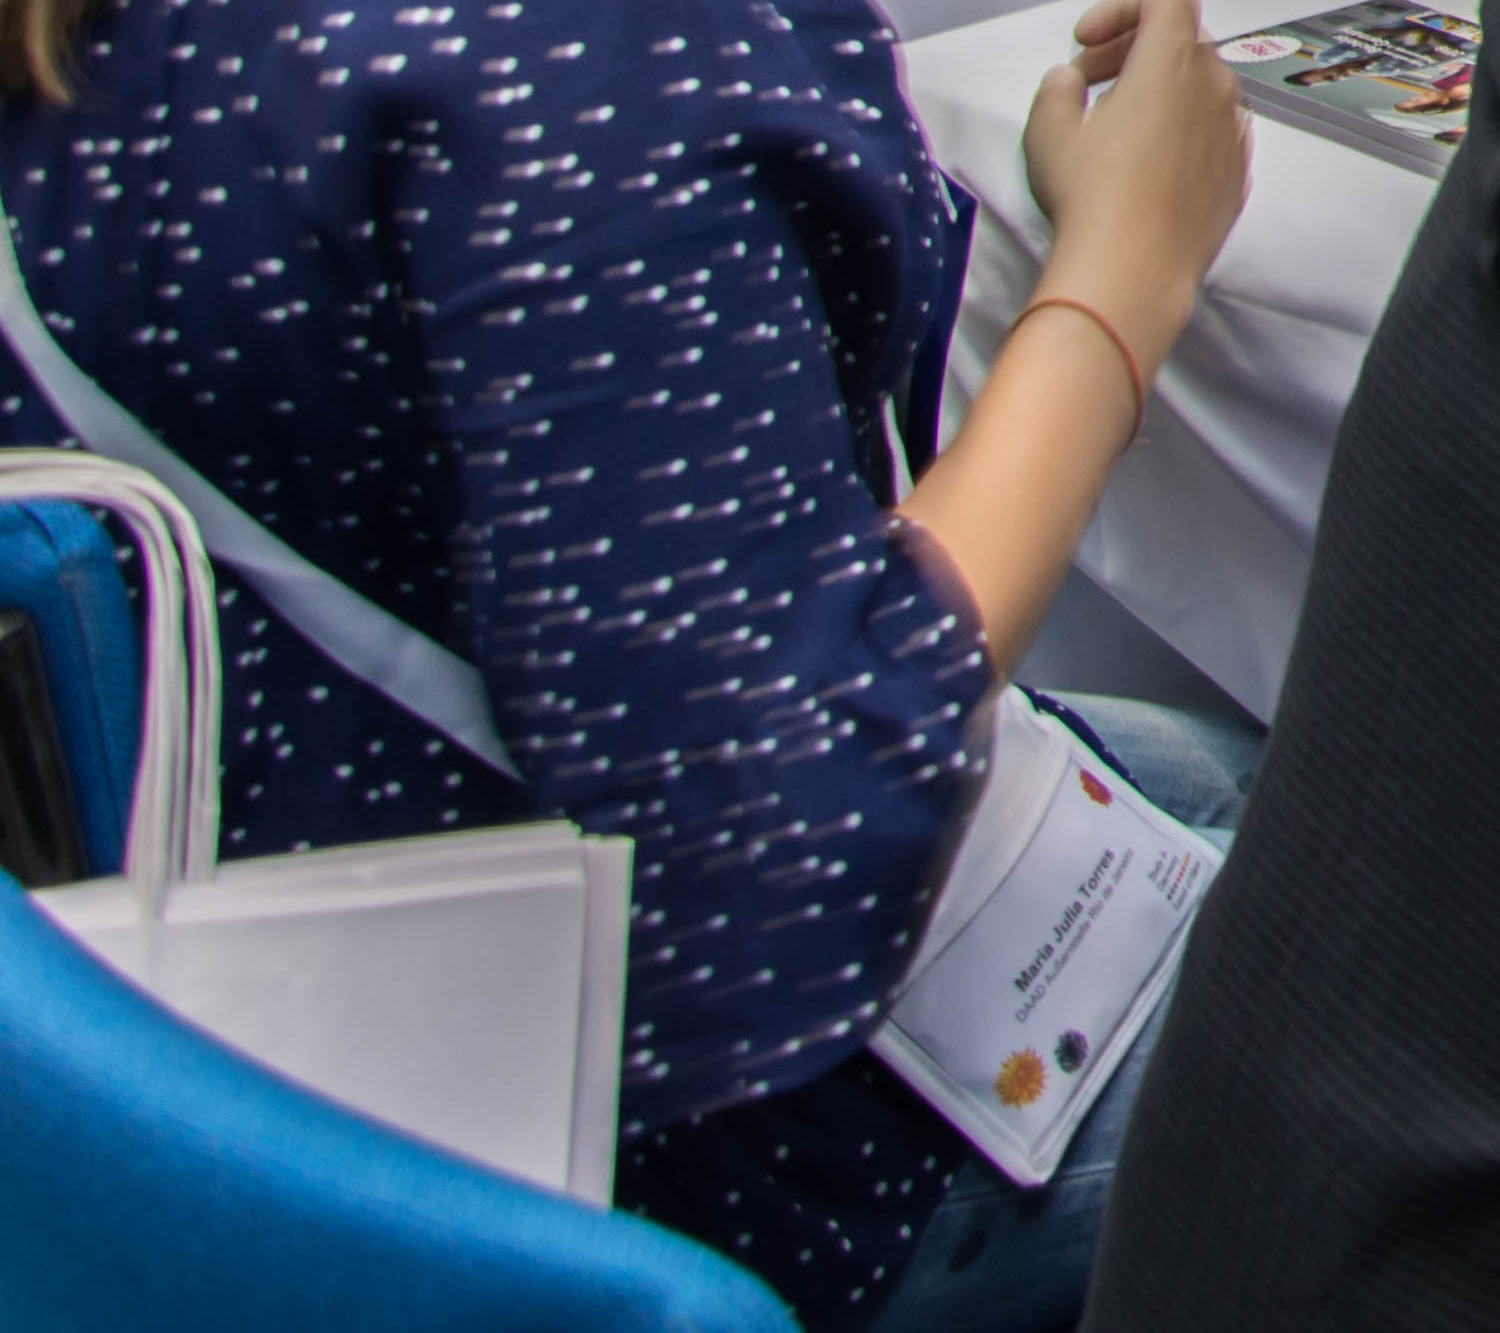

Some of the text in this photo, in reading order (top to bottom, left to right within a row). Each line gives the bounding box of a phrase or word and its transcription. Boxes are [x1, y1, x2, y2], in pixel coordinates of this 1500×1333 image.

[1014, 848, 1115, 992] Maria Julia Torres
